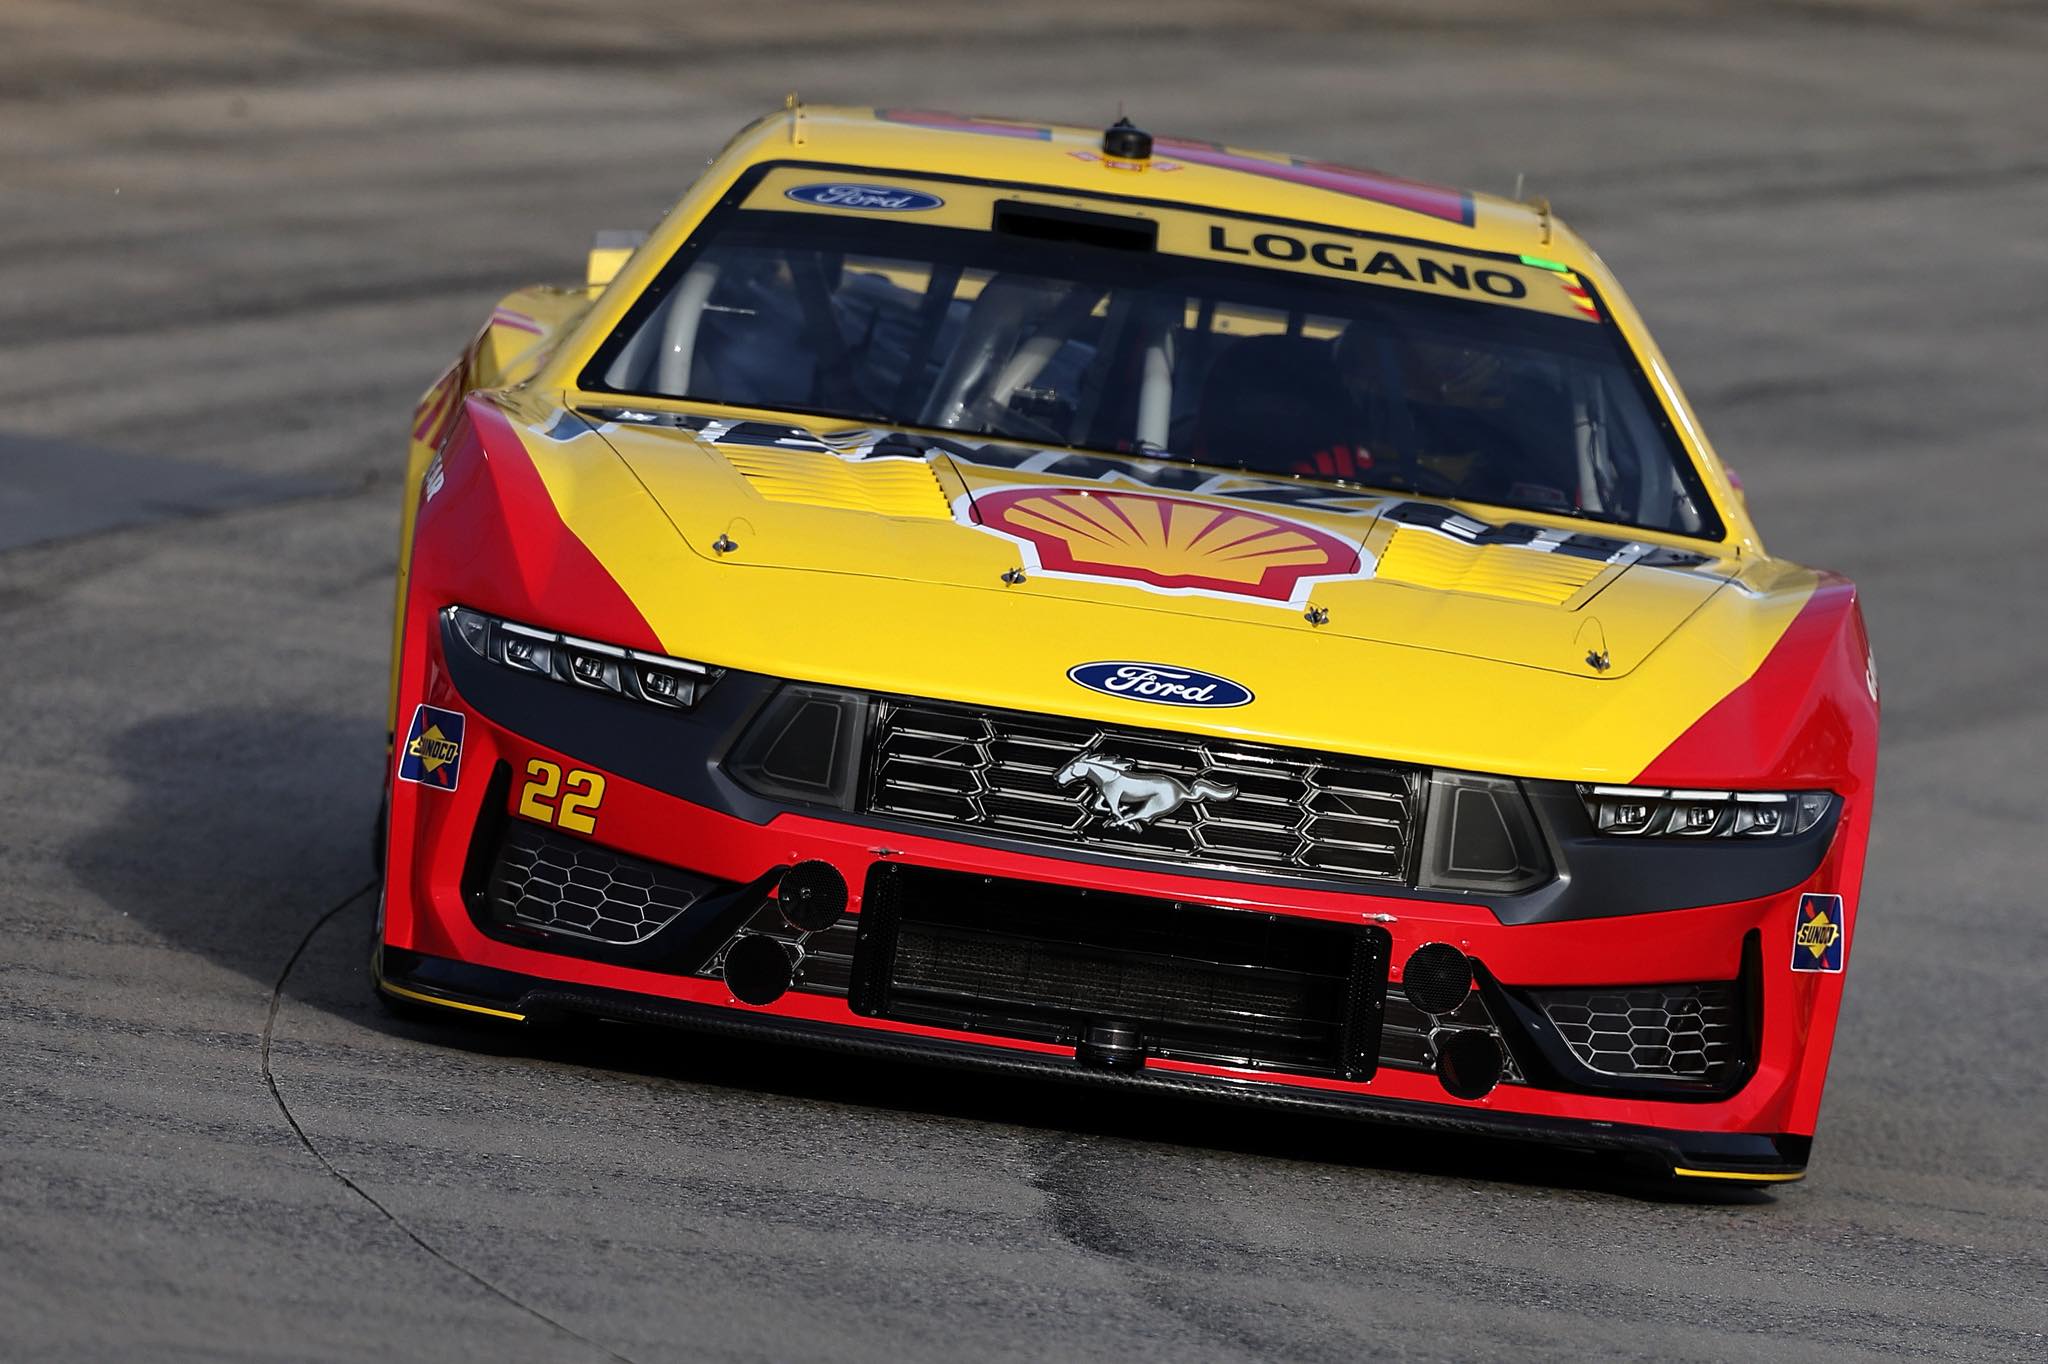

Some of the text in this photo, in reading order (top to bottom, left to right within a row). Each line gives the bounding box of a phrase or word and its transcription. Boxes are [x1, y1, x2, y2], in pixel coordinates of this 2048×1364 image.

[816, 186, 914, 209] Ford
[1209, 225, 1527, 300] LOGANO
[1104, 666, 1217, 702] Ford
[519, 758, 606, 835] 22
